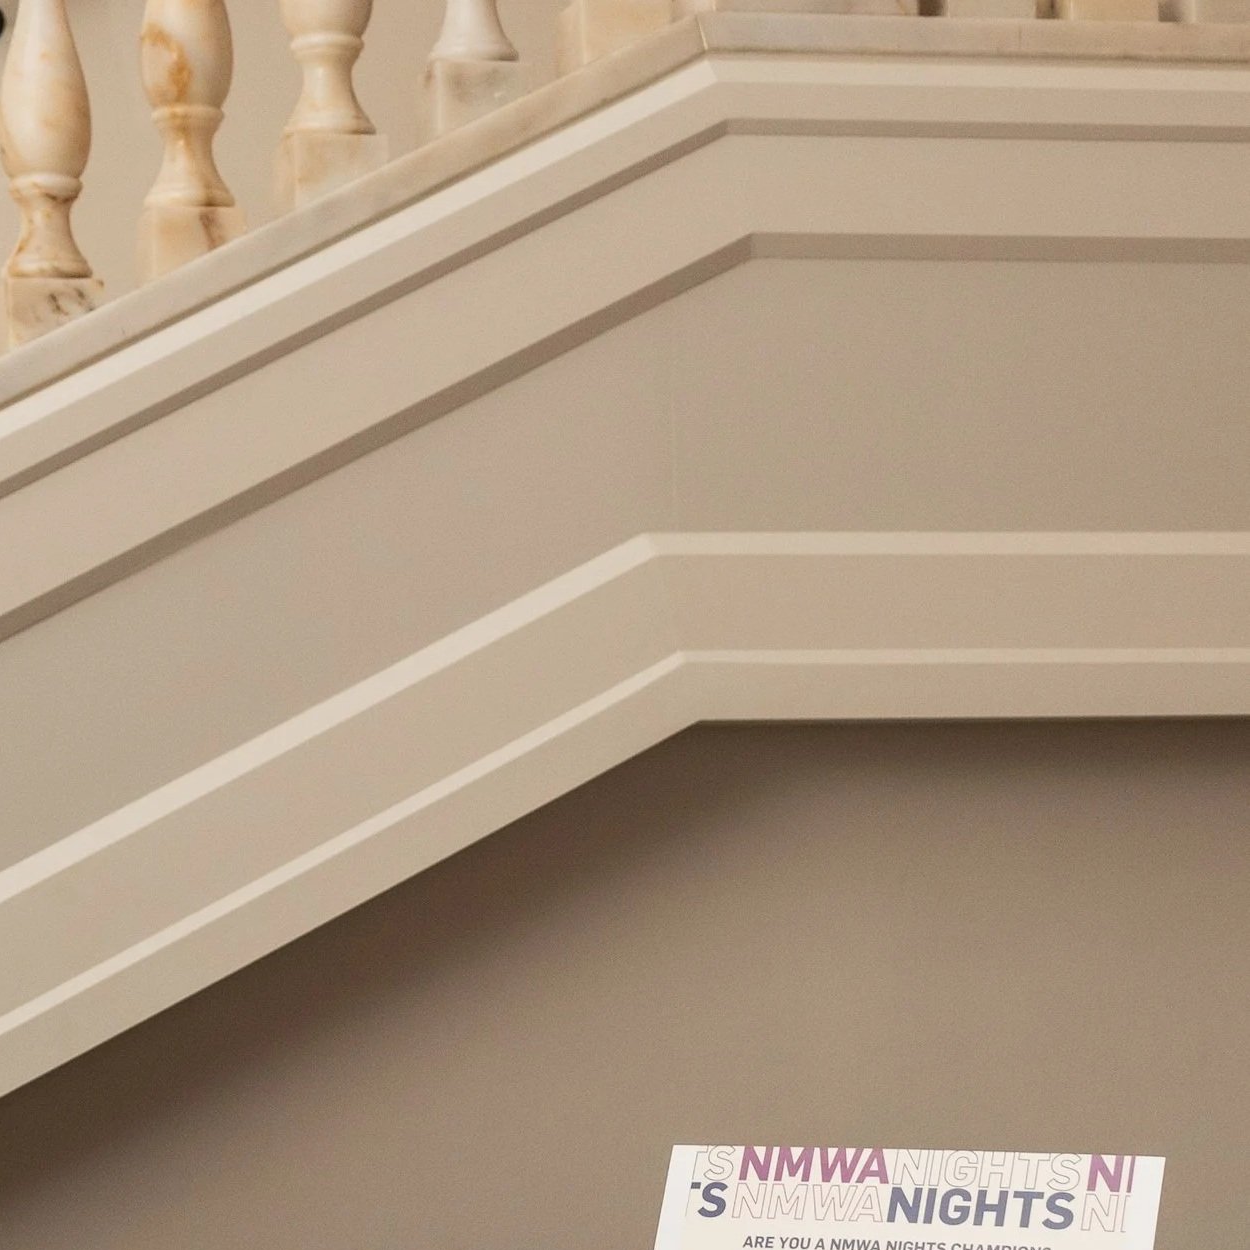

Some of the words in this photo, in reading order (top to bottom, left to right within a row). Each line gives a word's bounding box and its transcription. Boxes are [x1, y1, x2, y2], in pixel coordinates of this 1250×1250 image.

[739, 1146, 889, 1184] NMWA
[892, 1149, 1083, 1192] NIGHTS
[731, 1182, 884, 1223] NMWA
[886, 1187, 1076, 1231] NIGHTS
[742, 1235, 775, 1249] ARE
[779, 1236, 811, 1250] YOU
[814, 1237, 825, 1250] A
